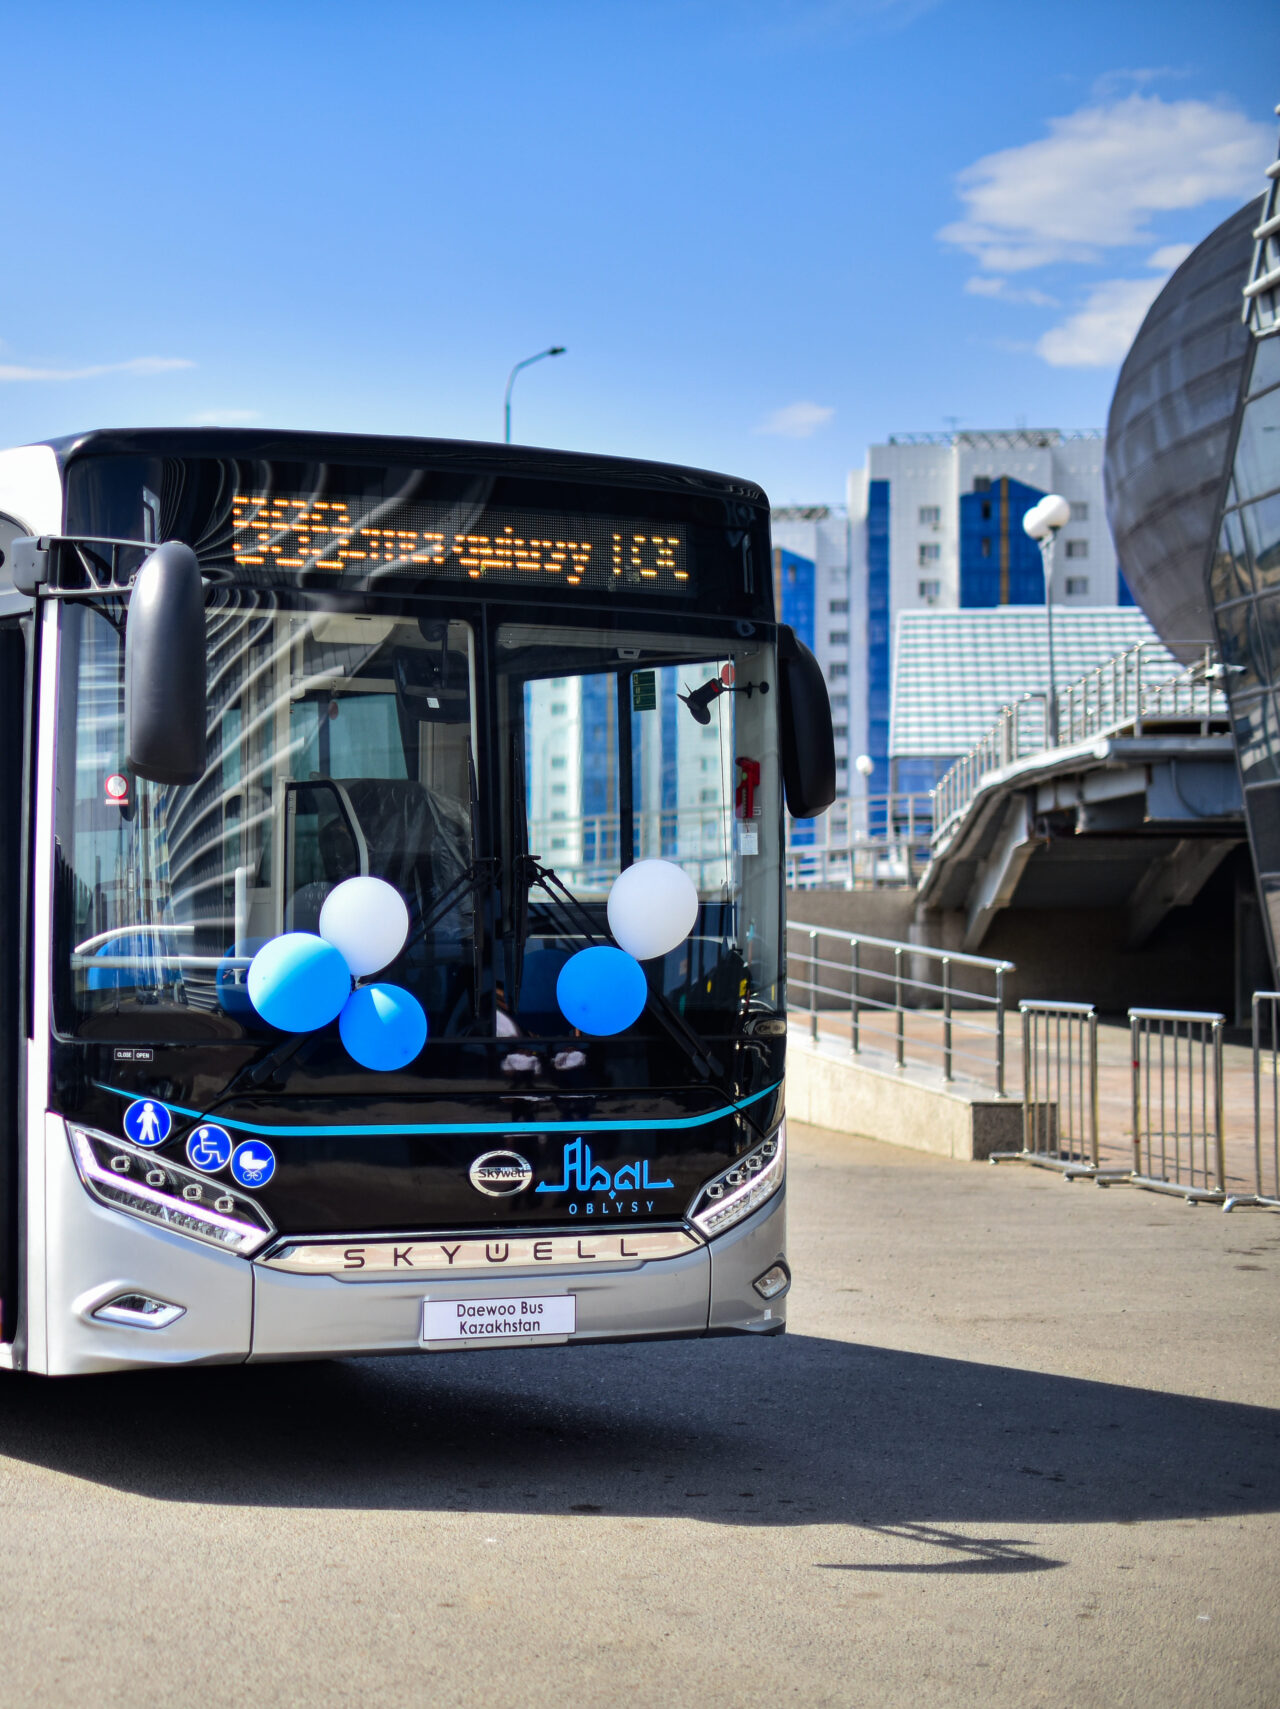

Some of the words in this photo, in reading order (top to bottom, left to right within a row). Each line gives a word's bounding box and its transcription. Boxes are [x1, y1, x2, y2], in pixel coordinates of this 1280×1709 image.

[477, 1168, 527, 1180] Skywell
[568, 1201, 655, 1215] OBLYSY
[343, 1238, 639, 1269] SKYWELL
[456, 1302, 516, 1318] Daewoo
[520, 1301, 544, 1315] Bus
[459, 1319, 541, 1335] Kazakhstan
